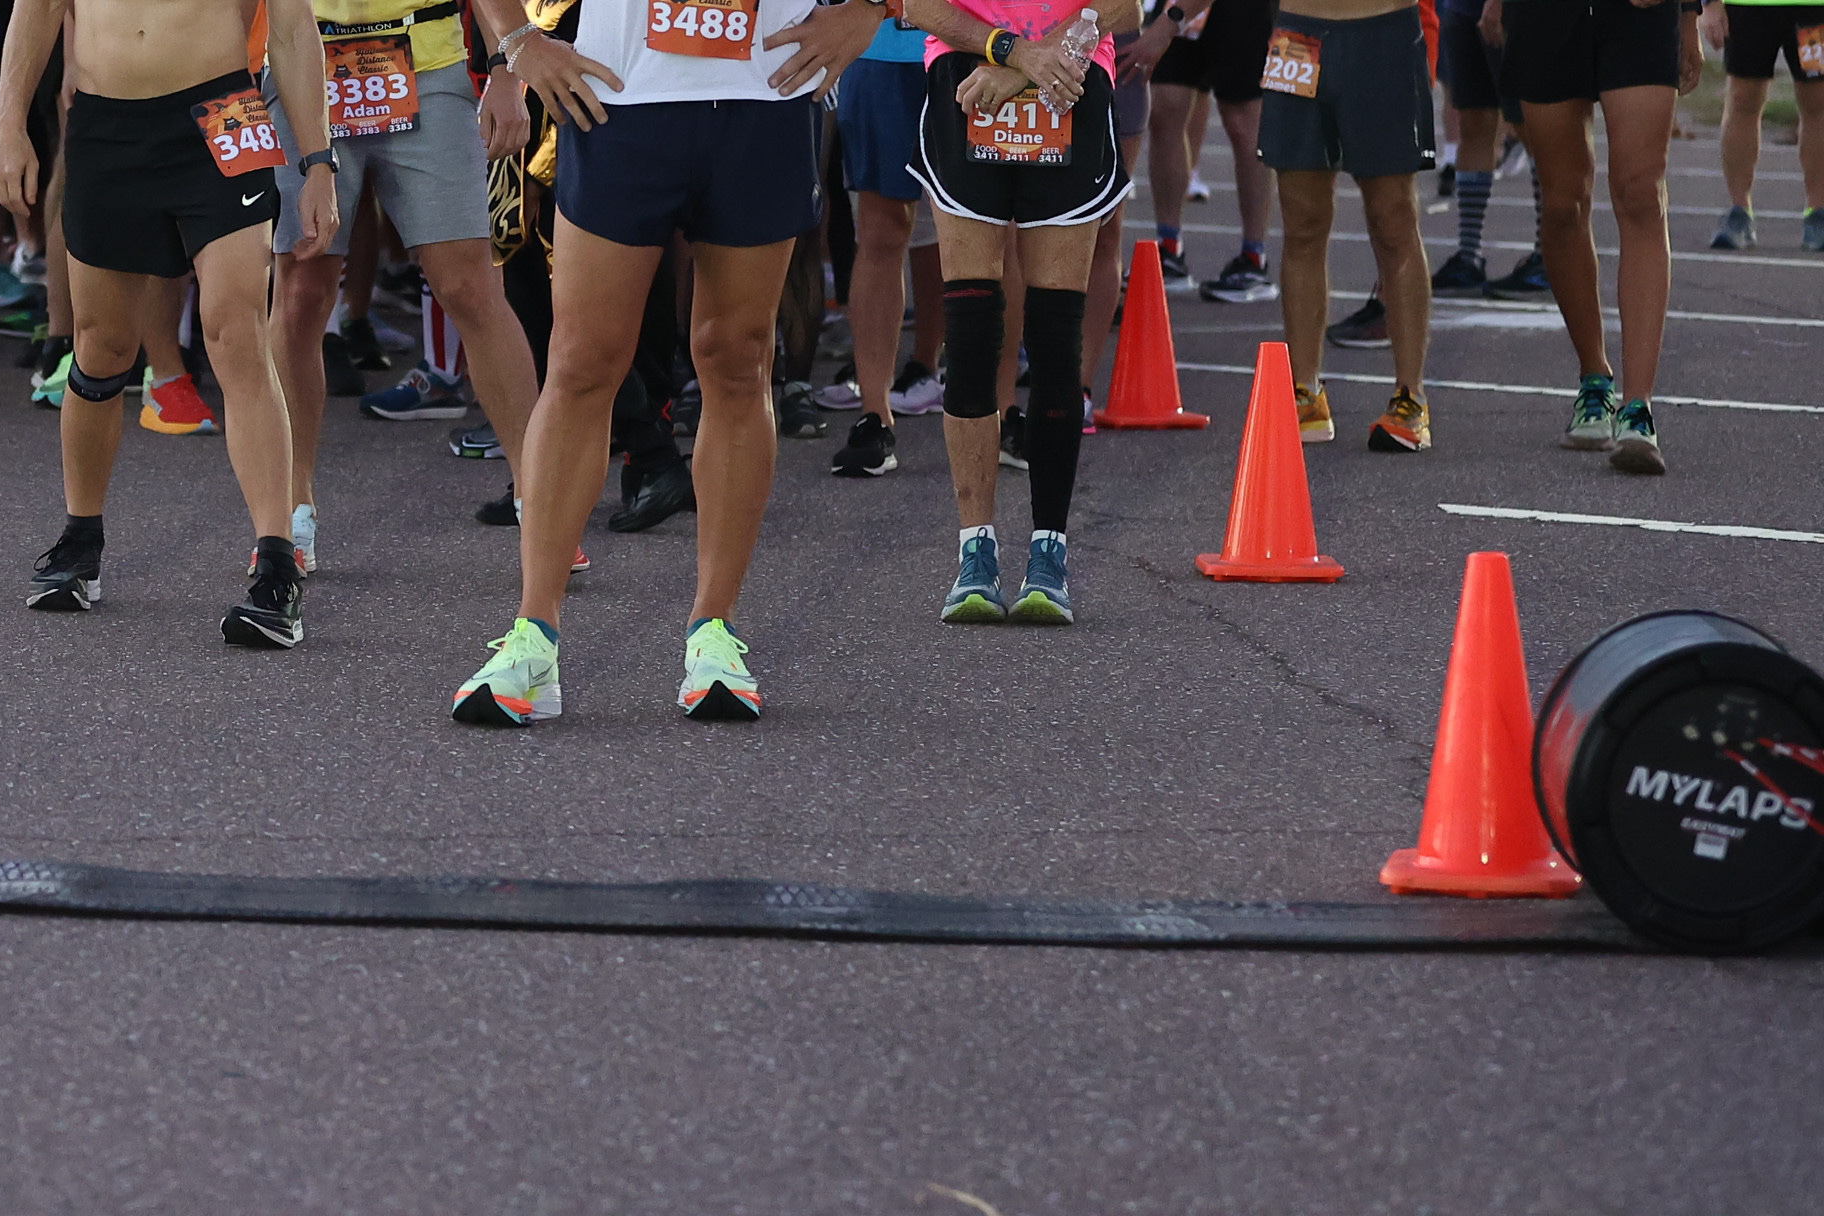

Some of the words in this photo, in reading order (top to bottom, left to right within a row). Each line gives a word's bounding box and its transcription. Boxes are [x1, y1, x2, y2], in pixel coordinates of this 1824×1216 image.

[651, 1, 749, 42] 3488
[336, 23, 392, 35] TRIATHLON
[357, 65, 389, 74] Classic
[324, 74, 408, 105] 3383
[343, 104, 390, 118] Adam
[356, 127, 380, 135] 3383
[388, 122, 413, 133] 3383
[994, 129, 1043, 144] Diane
[975, 152, 998, 160] 3411
[1626, 765, 1814, 830] MYLAPS
